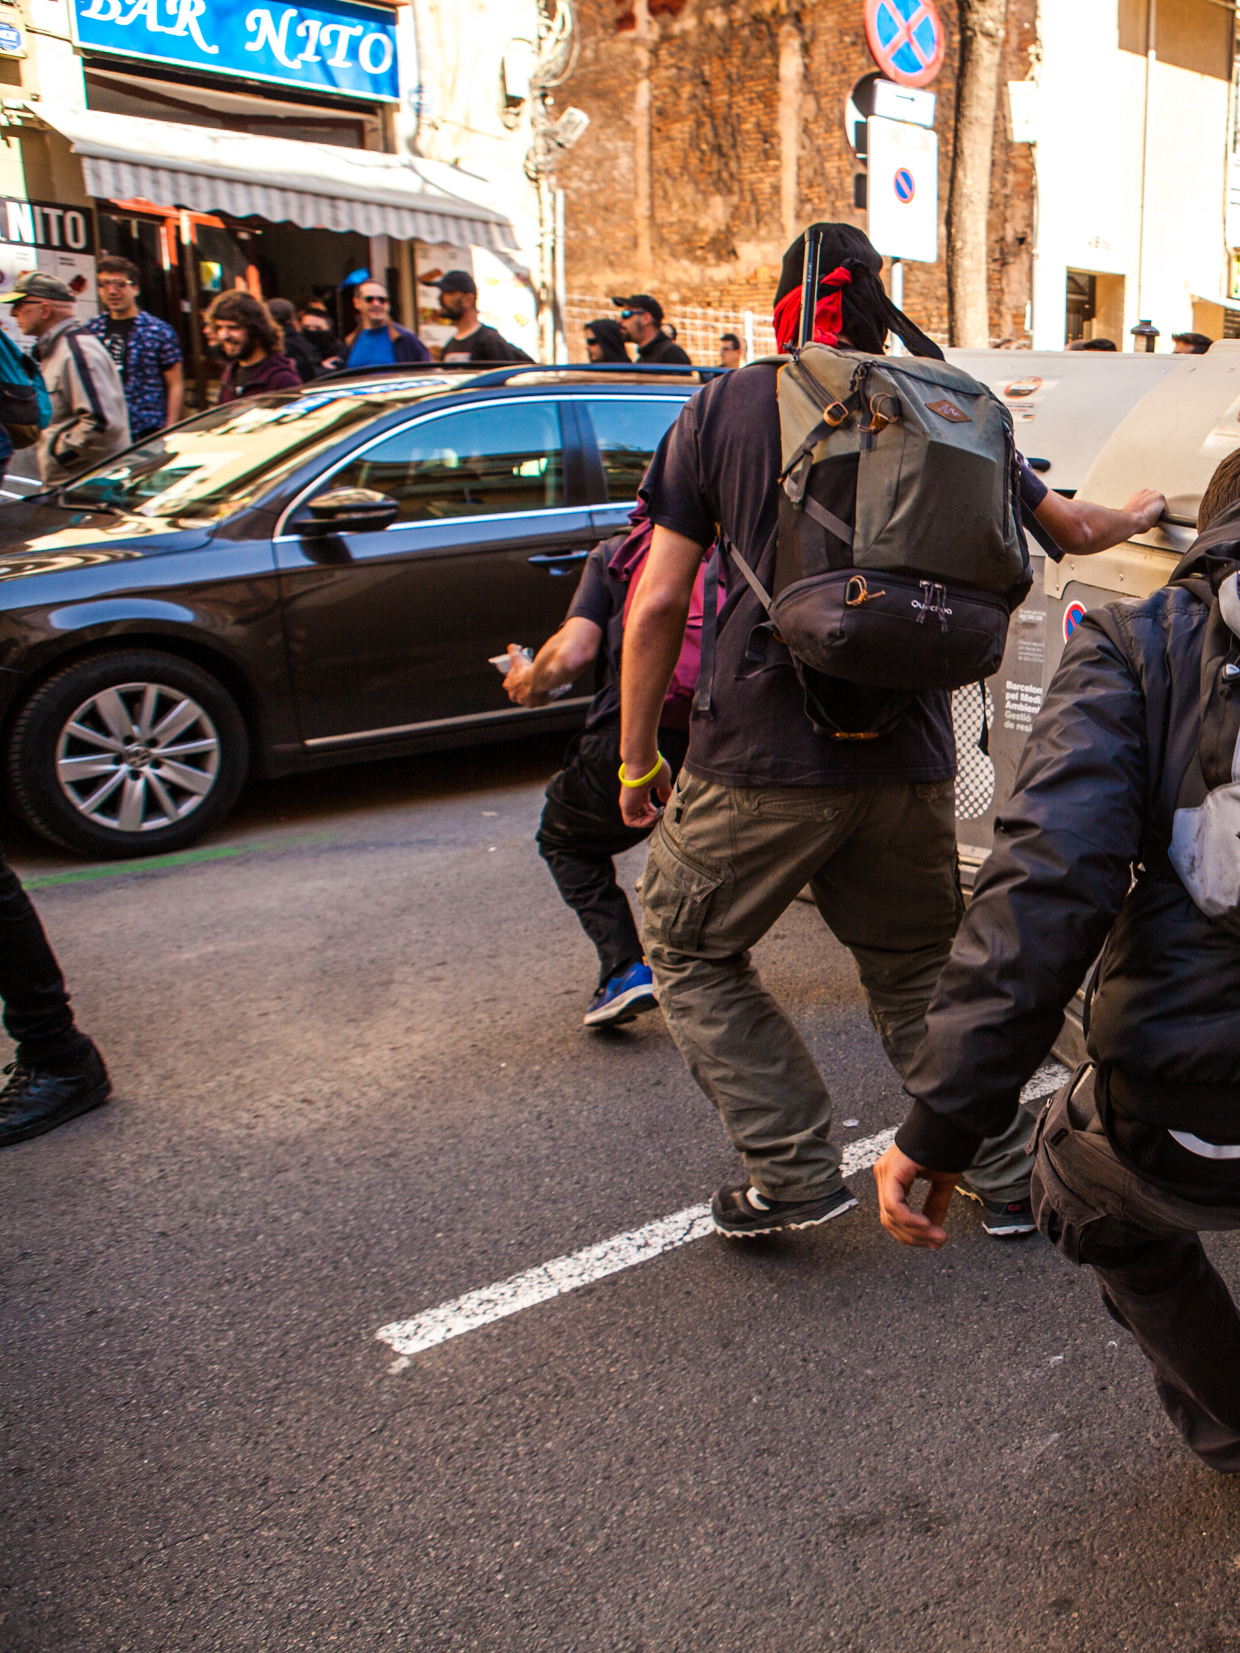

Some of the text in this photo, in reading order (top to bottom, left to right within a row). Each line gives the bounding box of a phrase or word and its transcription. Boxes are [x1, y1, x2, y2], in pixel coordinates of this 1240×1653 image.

[244, 8, 393, 74] NITO
[6, 201, 87, 250] NITO
[1003, 720, 1015, 729] de
